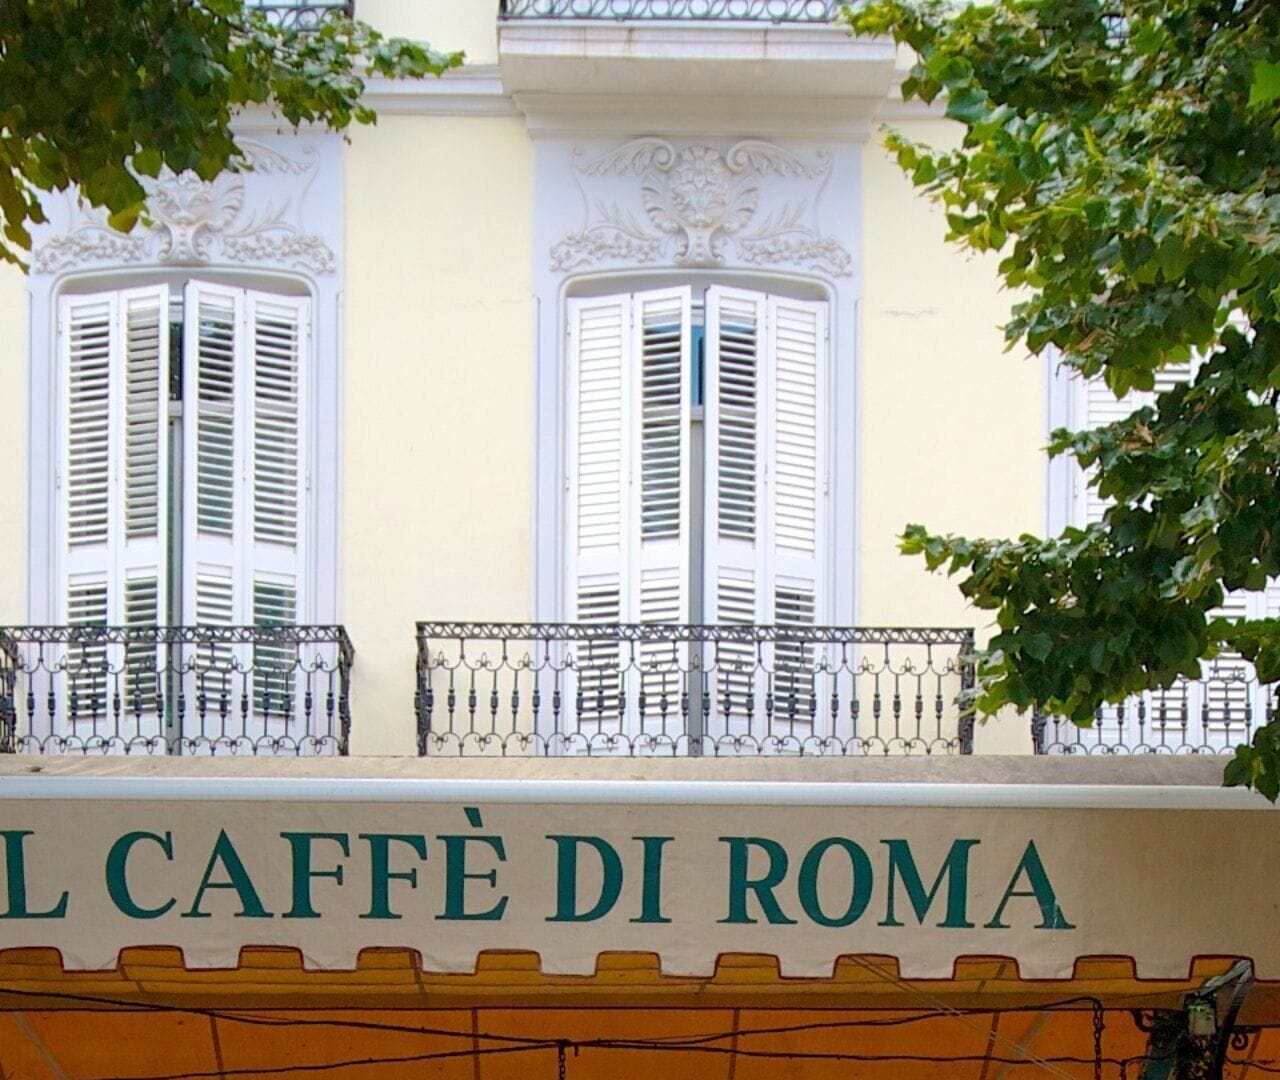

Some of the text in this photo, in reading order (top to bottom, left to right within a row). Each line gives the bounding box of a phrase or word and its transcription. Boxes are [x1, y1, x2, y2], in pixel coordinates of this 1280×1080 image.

[105, 807, 509, 921] CAFFÈ
[545, 834, 674, 923] DI
[716, 836, 1077, 929] ROMA
